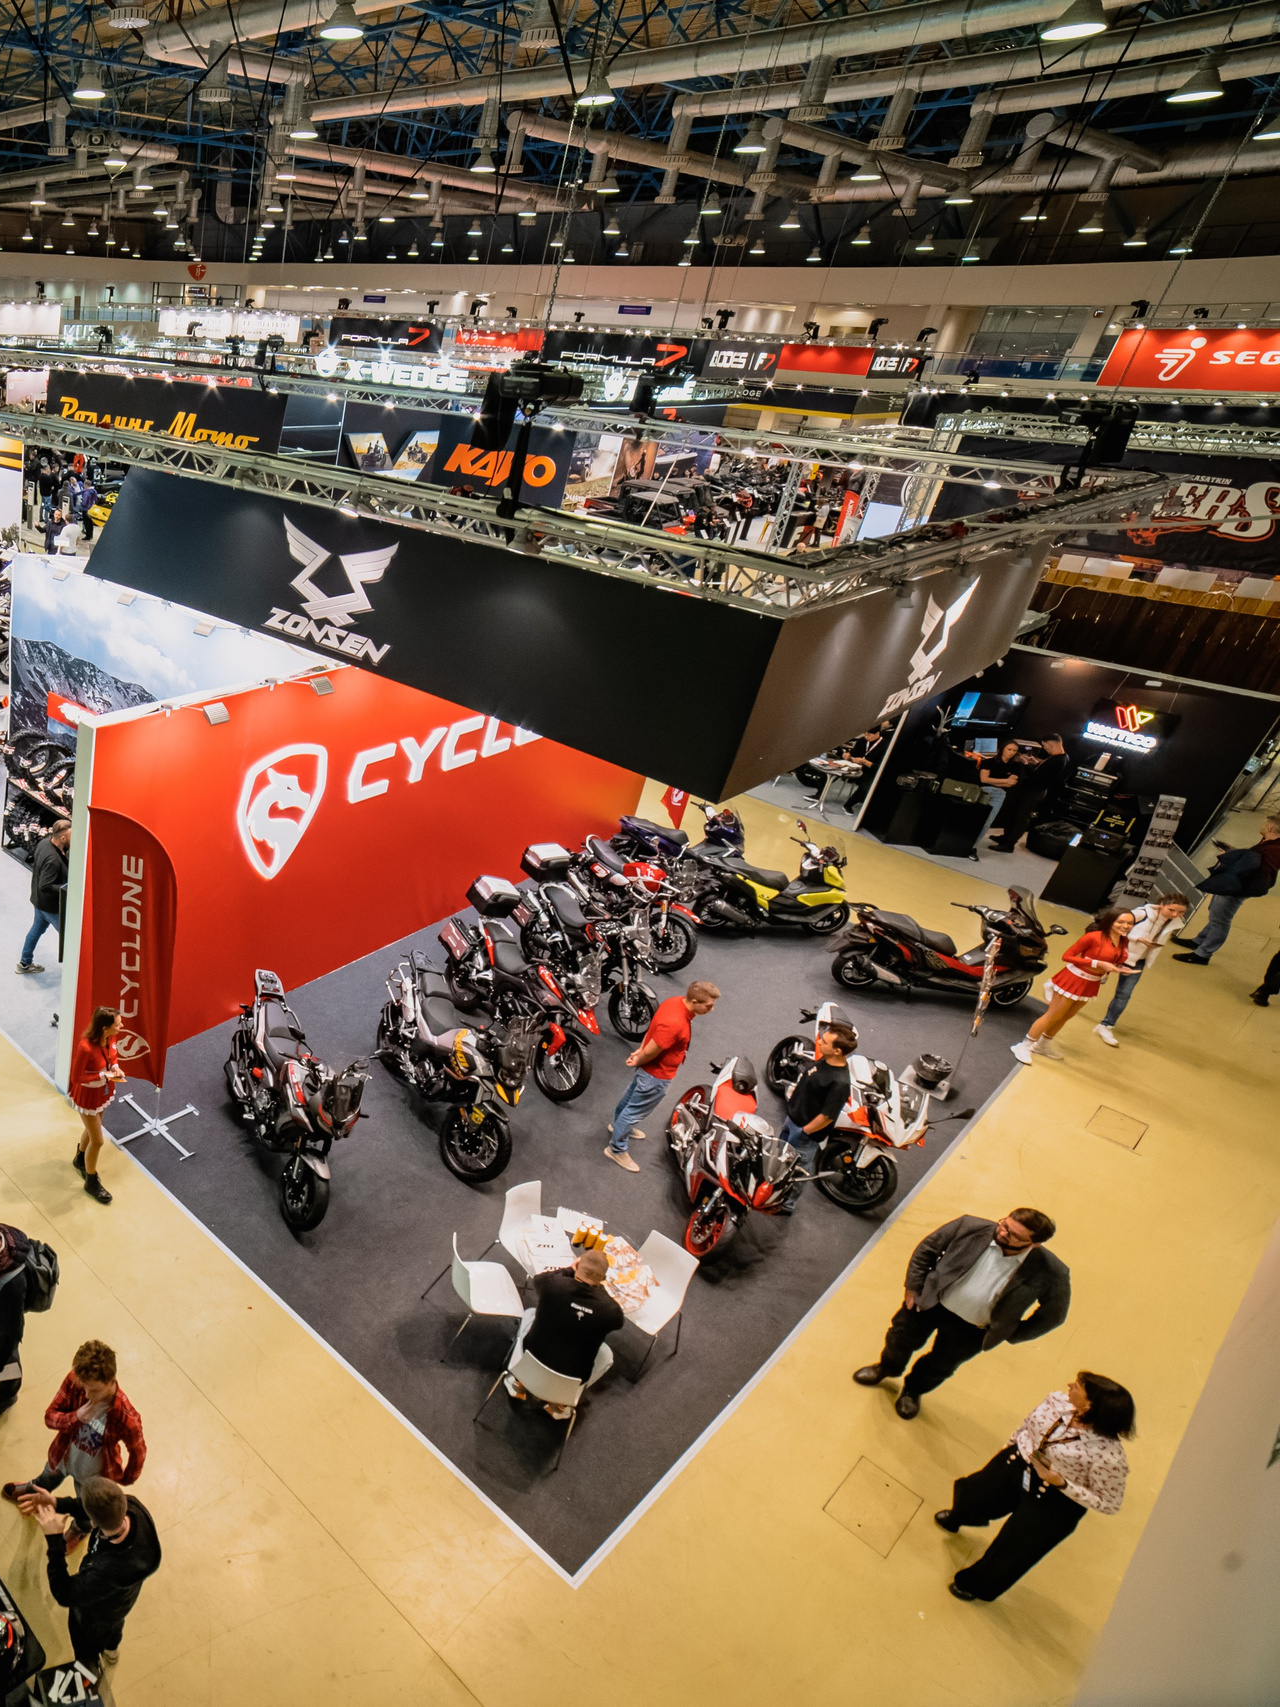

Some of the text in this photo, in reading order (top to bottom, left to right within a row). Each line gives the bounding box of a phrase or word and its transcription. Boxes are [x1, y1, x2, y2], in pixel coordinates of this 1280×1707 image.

[341, 327, 430, 346] FORMULA 7
[560, 343, 687, 367] FORMULA 7
[345, 359, 469, 393] X-WEDGE
[168, 411, 260, 450] Мото
[120, 854, 144, 1019] CYCLONE
